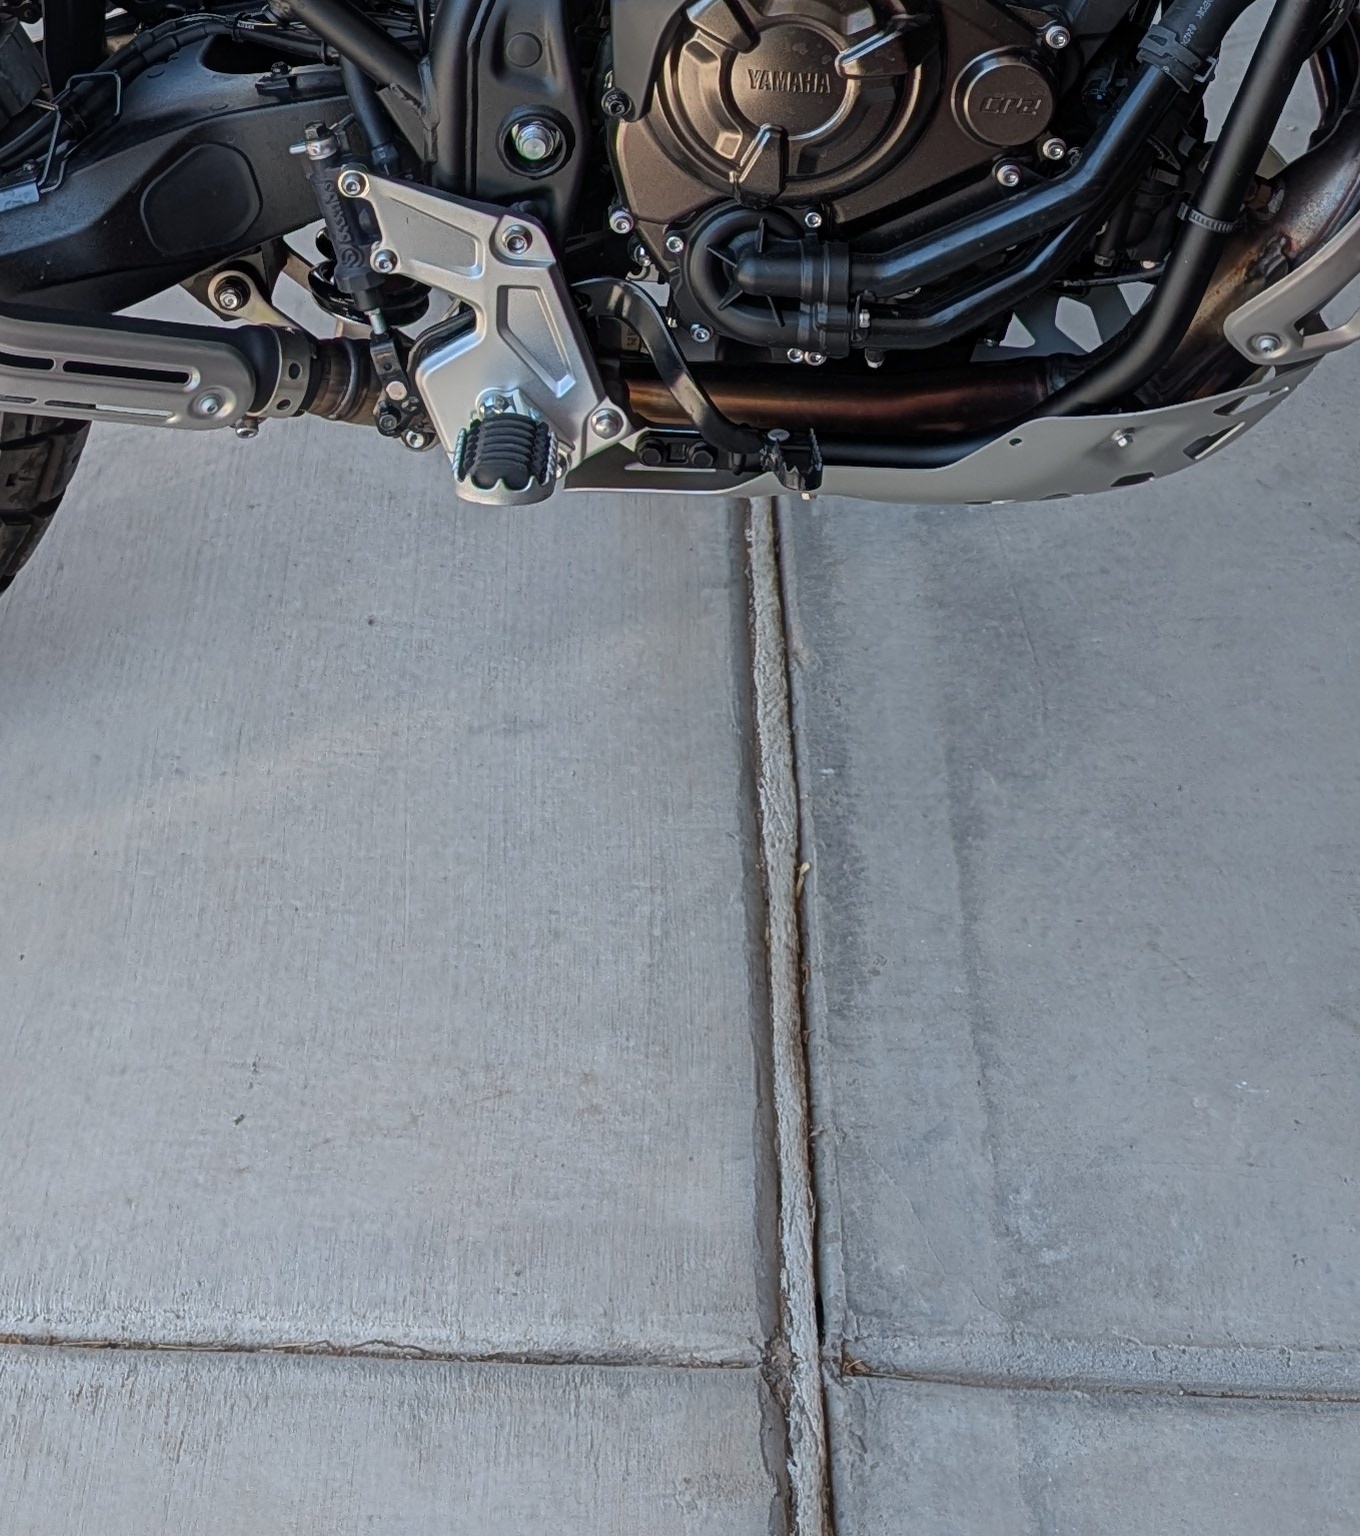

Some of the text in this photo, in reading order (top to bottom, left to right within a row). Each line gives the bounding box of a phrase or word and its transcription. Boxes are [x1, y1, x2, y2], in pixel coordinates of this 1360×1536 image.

[746, 68, 831, 94] YAMAHA
[979, 96, 1042, 116] CP2
[323, 178, 356, 250] brembo
